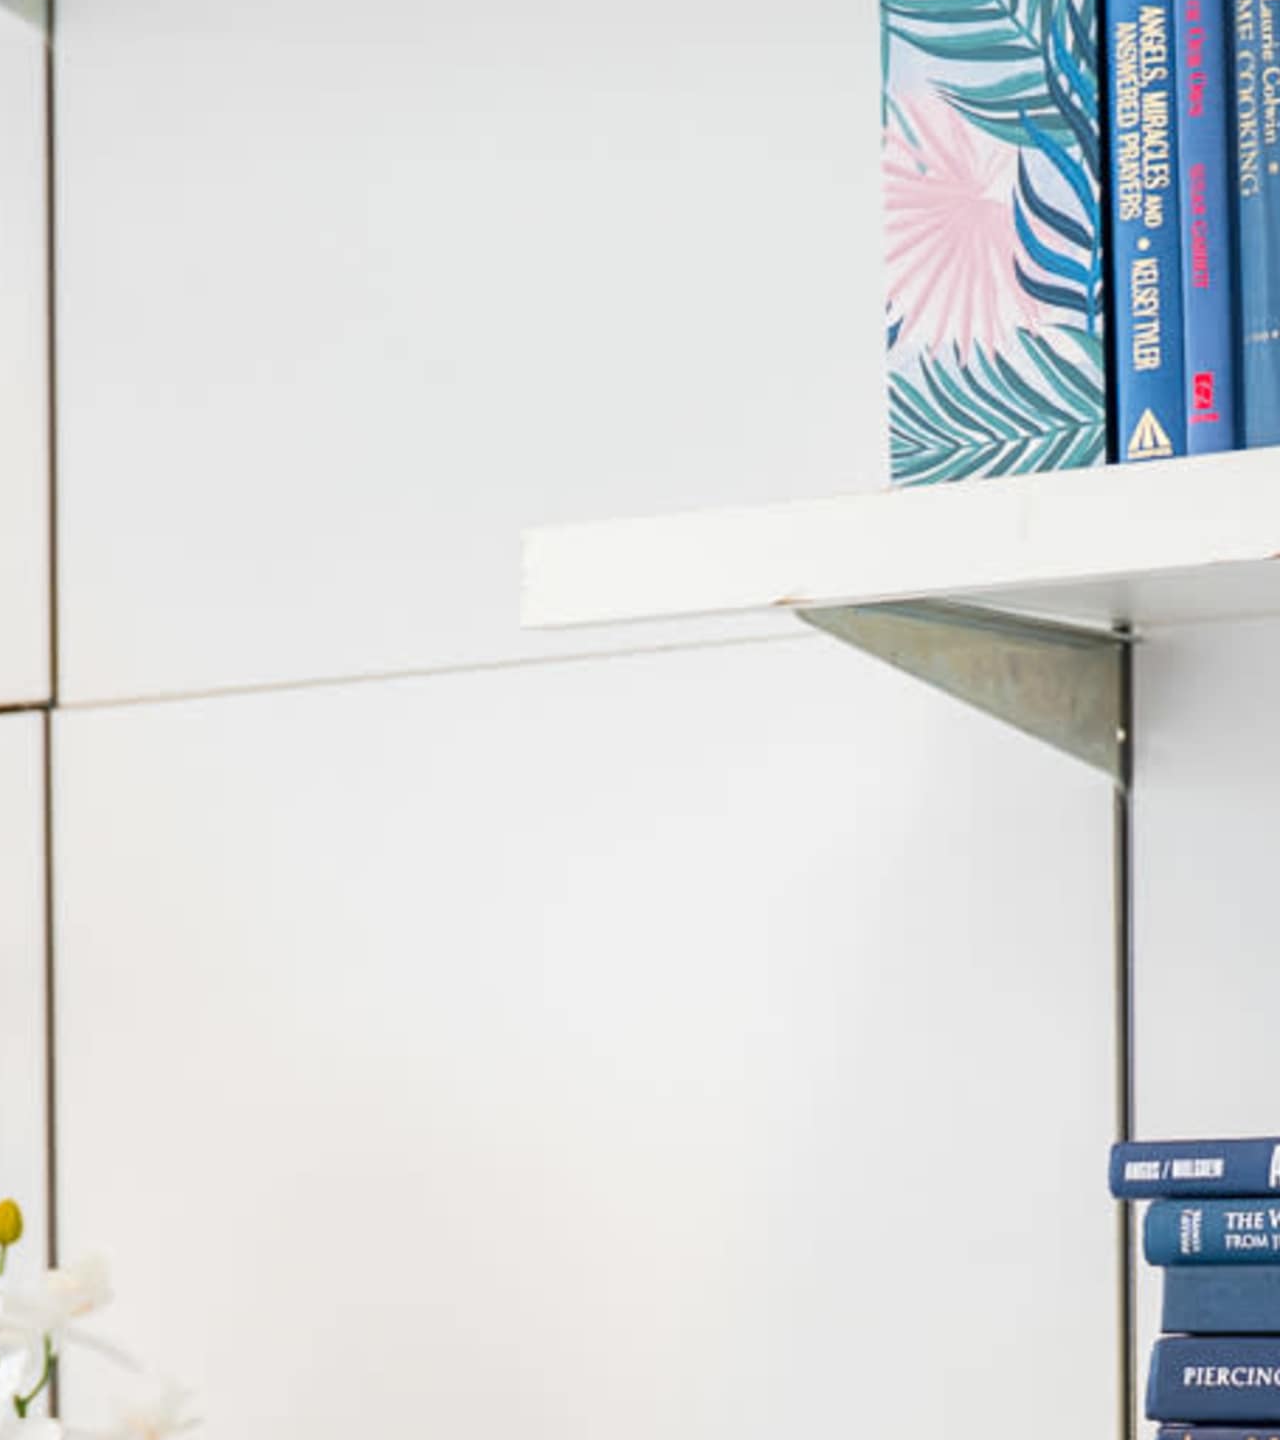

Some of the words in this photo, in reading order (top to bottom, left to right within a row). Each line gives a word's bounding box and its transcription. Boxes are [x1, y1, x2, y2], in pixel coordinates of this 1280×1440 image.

[1116, 21, 1140, 129] ANSWERED
[1139, 5, 1168, 89] ANGELS,
[1141, 90, 1170, 189] MIRACLES
[1237, 49, 1260, 198] COOKING
[1118, 134, 1142, 222] PRAYERS
[1143, 194, 1164, 229] AND
[1131, 257, 1160, 317] KELSEY
[1133, 319, 1161, 372] TYLER
[1224, 1210, 1265, 1230] THE
[1224, 1233, 1268, 1250] FROM
